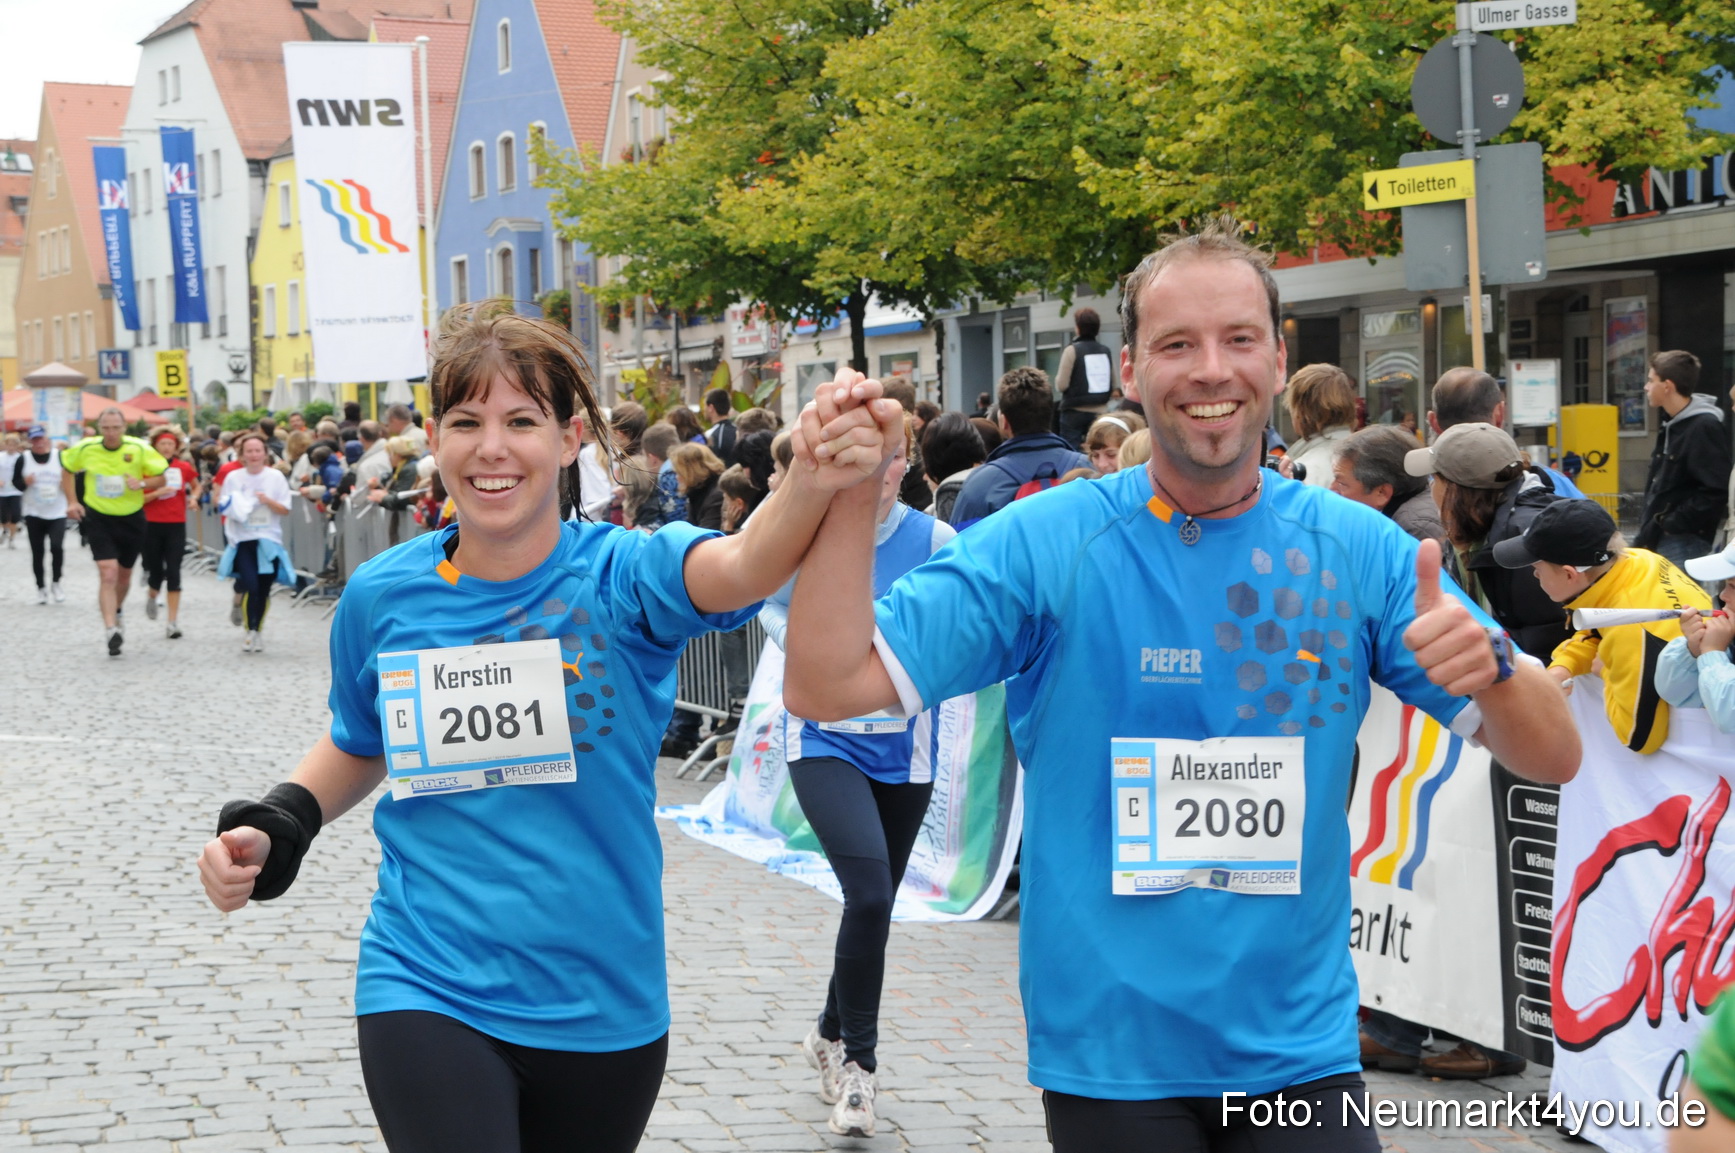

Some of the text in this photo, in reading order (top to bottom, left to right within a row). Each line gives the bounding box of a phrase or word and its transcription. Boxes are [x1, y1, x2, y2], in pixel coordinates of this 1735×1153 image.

[1478, 4, 1568, 24] Ulmer Gasse
[1387, 177, 1456, 196] Toiletten
[180, 200, 197, 268] RUPPERT
[165, 364, 182, 386] B
[433, 662, 512, 690] Kerstin
[396, 709, 407, 728] C
[439, 699, 544, 745] 2081
[505, 762, 572, 777] PFLEIDERER
[1170, 753, 1283, 781] Alexander
[1128, 797, 1139, 817] C
[1525, 798, 1557, 816] Wasser
[1174, 798, 1285, 838] 2080
[1231, 871, 1296, 884] PFLEIDERER
